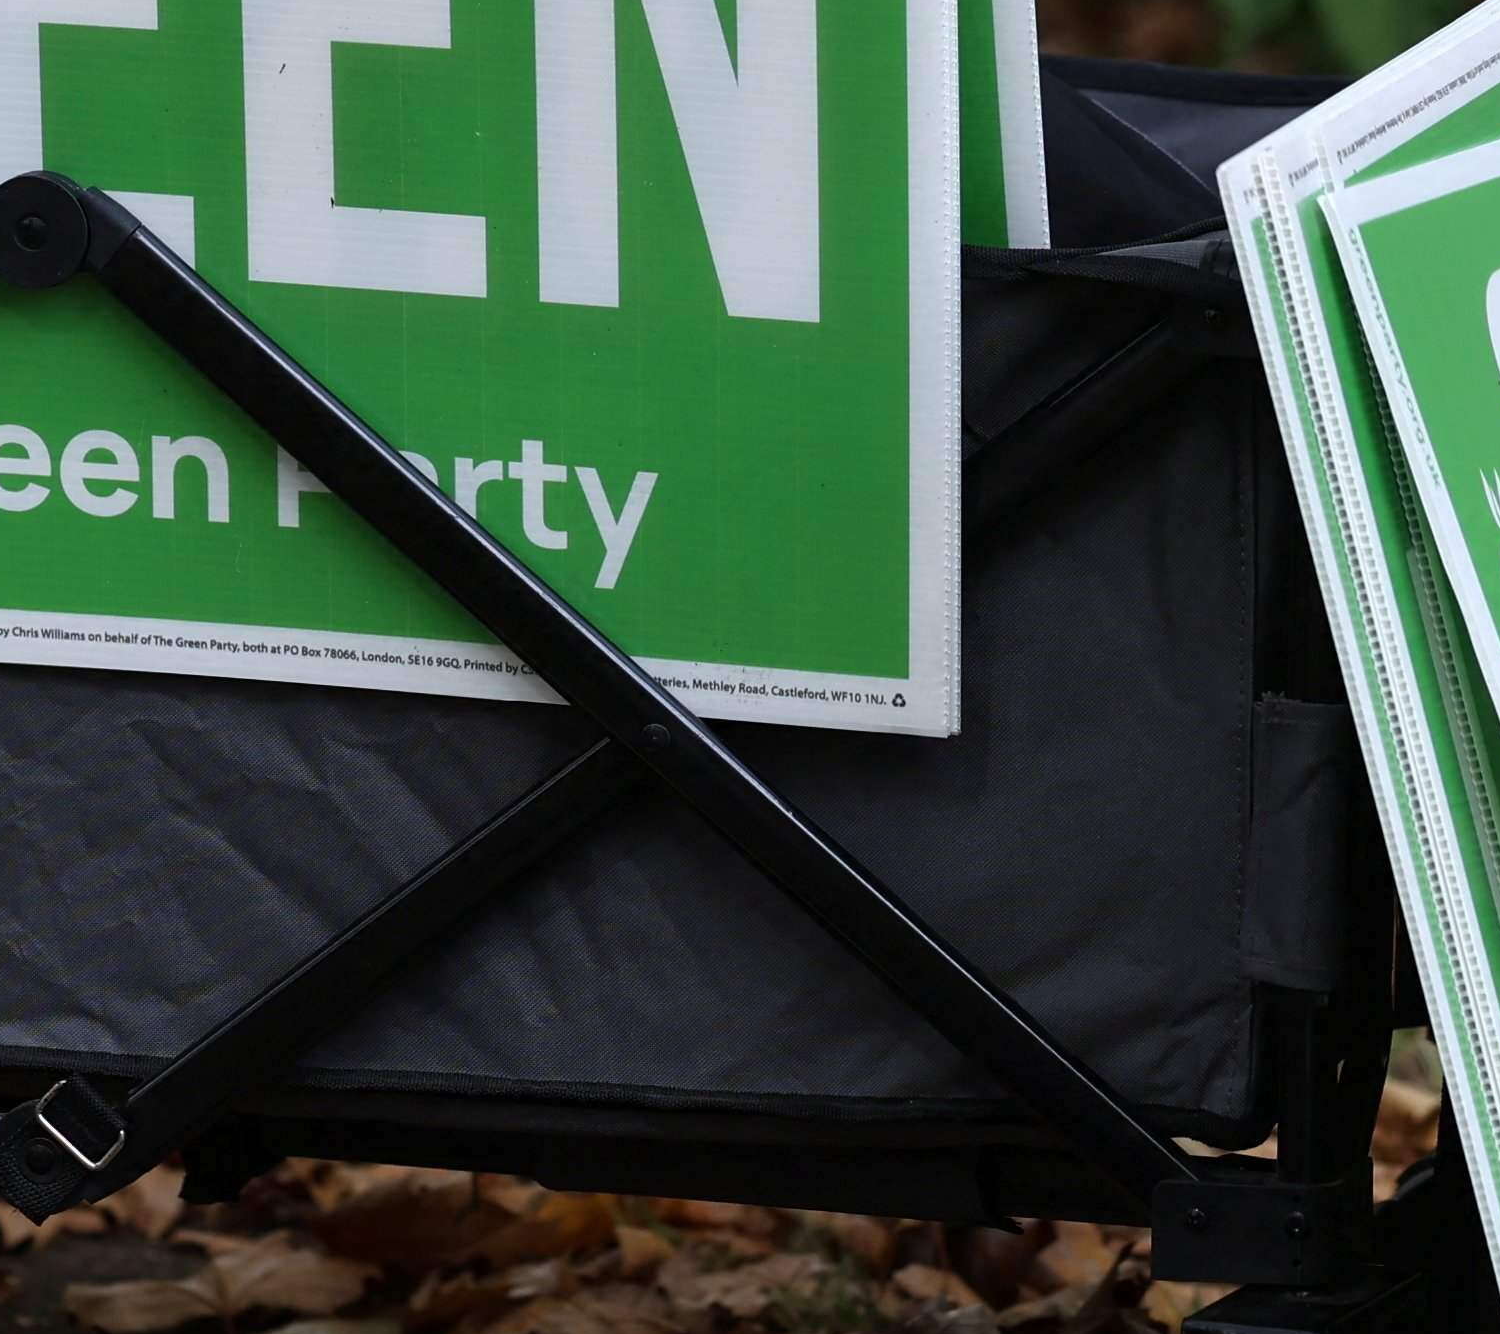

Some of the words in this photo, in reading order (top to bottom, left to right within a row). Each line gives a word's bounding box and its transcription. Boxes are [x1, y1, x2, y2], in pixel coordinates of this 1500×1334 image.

[12, 626, 39, 639] Chris
[41, 628, 86, 642] Williams
[88, 632, 101, 643] on
[104, 631, 138, 645] behalf
[140, 634, 153, 645] of
[153, 635, 173, 647] The
[175, 636, 208, 650] Green
[210, 639, 240, 653] Party,
[243, 642, 268, 655] both
[270, 645, 281, 656] at
[283, 645, 299, 657] PO
[301, 646, 322, 658] Box
[324, 647, 360, 662] 78066,
[362, 650, 405, 665] London,
[407, 654, 434, 667] SE16
[436, 657, 462, 671] 9GQ.
[464, 658, 502, 673] Printed
[505, 660, 518, 676] by
[692, 678, 736, 695] Methley
[738, 682, 769, 697] Road,
[771, 685, 829, 702] Castleford,
[831, 690, 862, 704] WF10
[864, 693, 887, 706] 1NJ.
